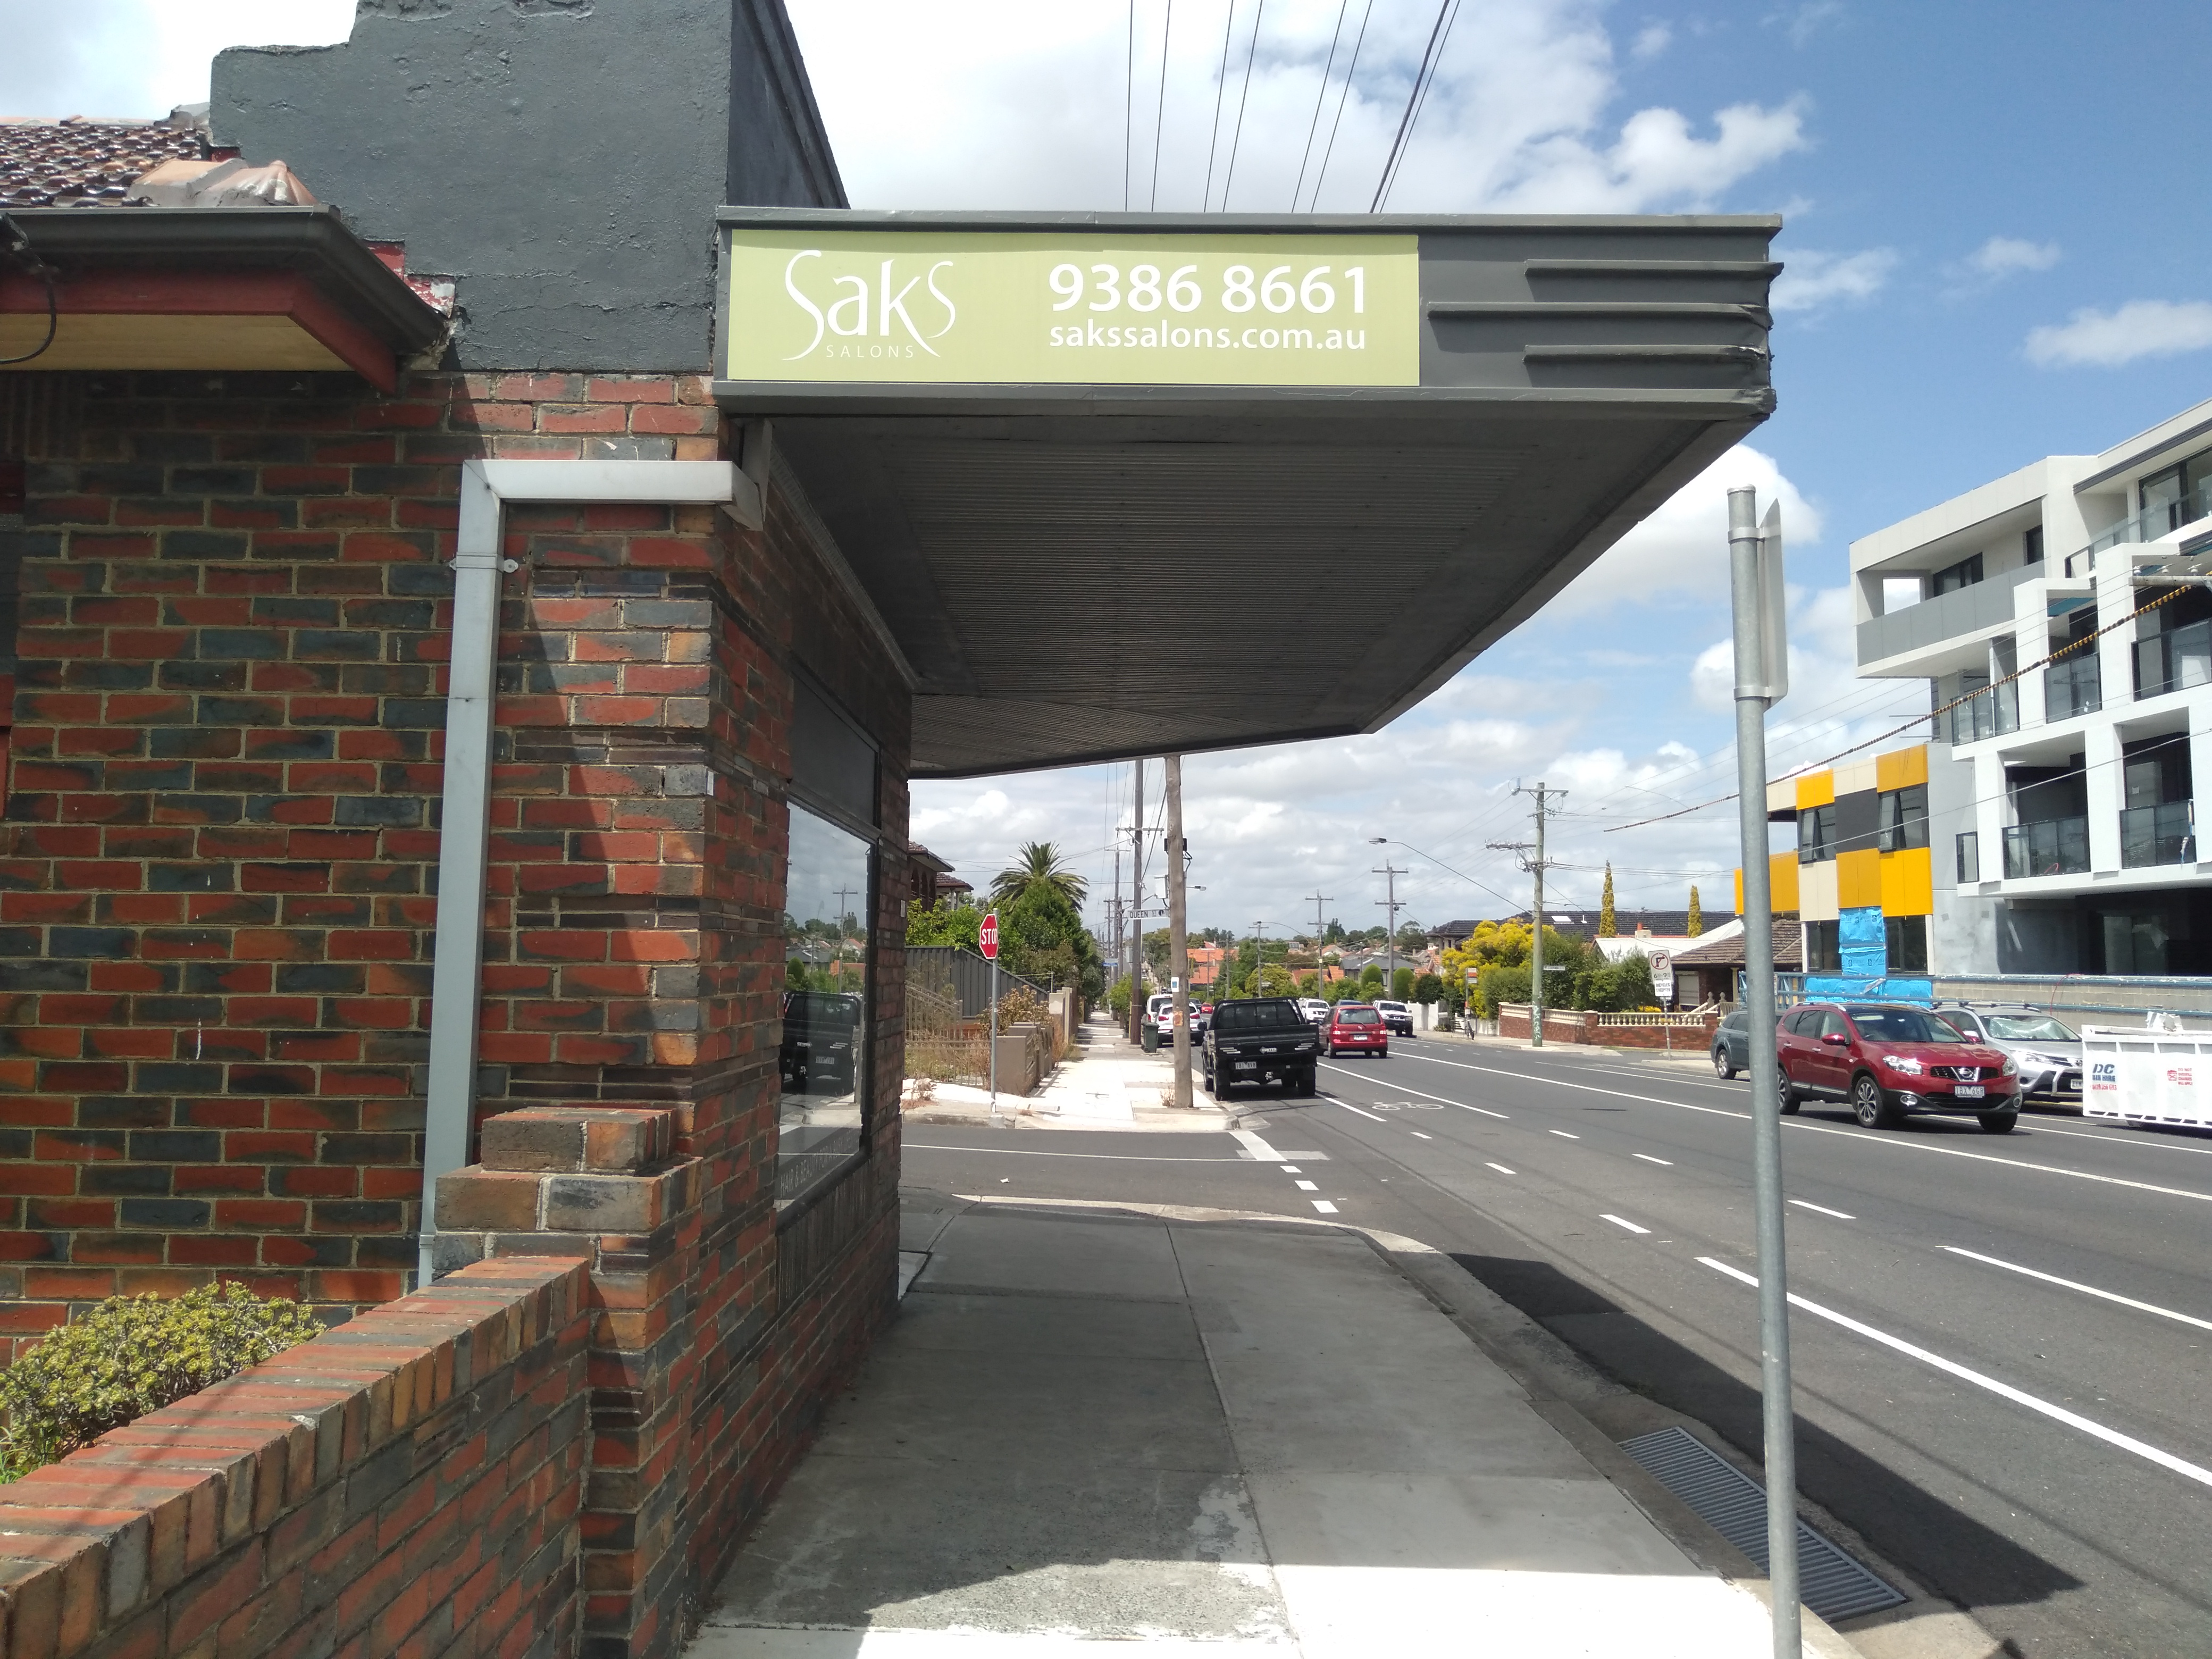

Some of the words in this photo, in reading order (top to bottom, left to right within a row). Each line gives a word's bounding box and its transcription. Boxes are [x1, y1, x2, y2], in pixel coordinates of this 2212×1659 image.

[1049, 263, 1202, 313] 9386
[1221, 264, 1364, 314] 8661
[781, 249, 956, 361] Saks
[1049, 319, 1365, 349] sakssalons.com.au
[826, 345, 914, 358] SALONS
[2092, 1063, 2115, 1074] DC
[780, 1168, 793, 1199] HAIR
